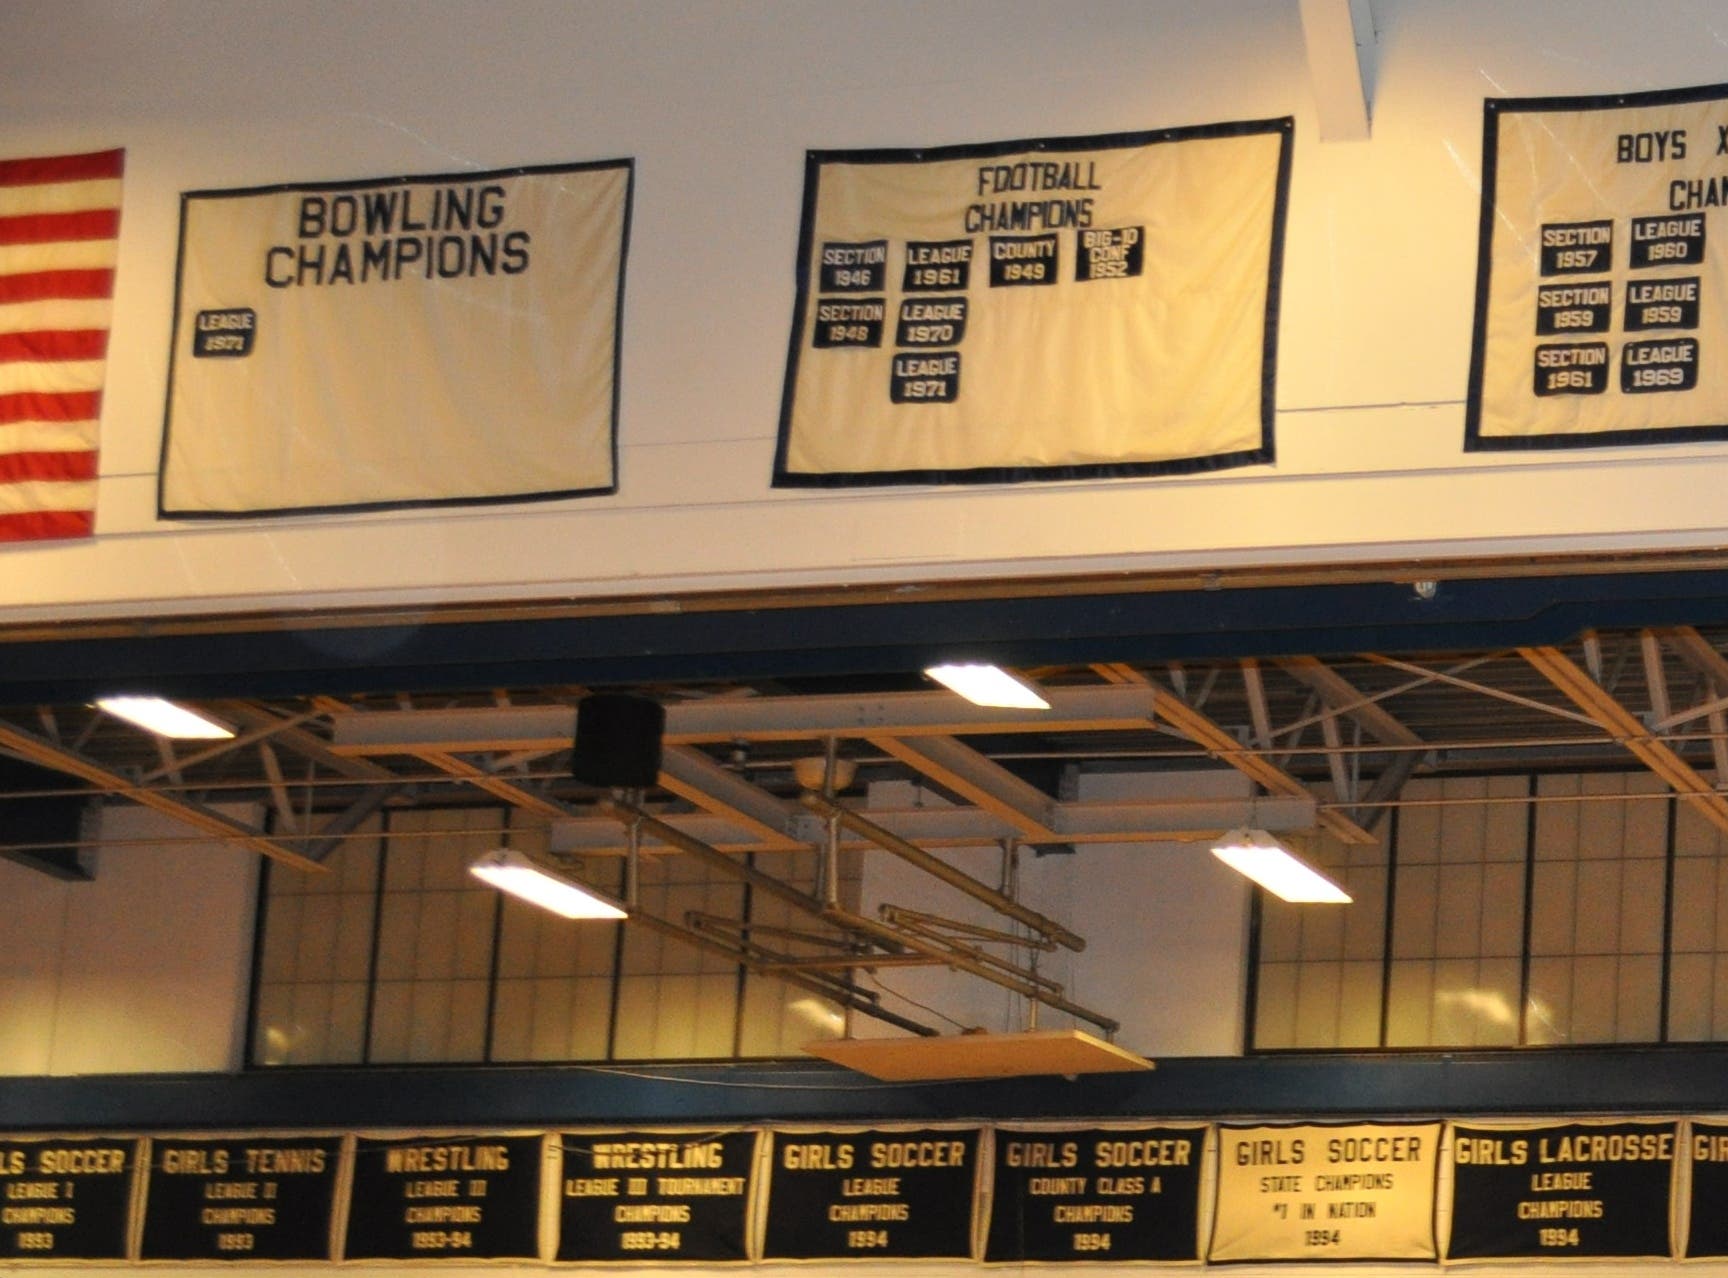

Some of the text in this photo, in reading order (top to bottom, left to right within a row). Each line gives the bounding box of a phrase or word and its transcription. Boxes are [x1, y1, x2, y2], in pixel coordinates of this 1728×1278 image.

[1616, 130, 1687, 163] BOYS
[978, 162, 1101, 196] FOOTBALL
[299, 185, 506, 238] BOWLING
[965, 198, 1096, 234] CHAMPIONS
[1083, 229, 1139, 248] BIG-10
[1543, 226, 1610, 247] SECTION
[1635, 219, 1702, 240] LEAGUE
[265, 231, 531, 288] CHAMPIONS
[823, 246, 886, 266] SECTION
[908, 245, 971, 265] LEAGUE
[992, 239, 1056, 261] COUNTY
[1089, 246, 1130, 263] CONF
[1556, 250, 1598, 268] 1957
[1648, 243, 1688, 260] 1960
[834, 270, 871, 286] 1946
[913, 269, 960, 286] 1961
[1003, 263, 1046, 281] 1949
[1538, 287, 1610, 307] SECTION
[1629, 283, 1697, 304] LEAGUE
[199, 313, 253, 330] LEAGUE
[819, 304, 883, 322] SECTION
[902, 303, 964, 321] LEAGUE
[1553, 310, 1594, 328] 1959
[1641, 306, 1682, 324] 1959
[905, 324, 953, 342] 1970
[1537, 348, 1606, 368] SECTION
[1626, 344, 1694, 364] LEAGUE
[896, 357, 958, 377] LEAGUE
[1633, 367, 1684, 386] 1969
[903, 380, 947, 398] 1971
[1547, 371, 1593, 389] 1961
[592, 1143, 724, 1170] WRESTLING
[784, 1142, 966, 1170] GIRLS SOCCER
[1006, 1140, 1191, 1168] GIRLS SOCCER
[1235, 1136, 1422, 1167] GIRLS SOCCER
[1455, 1133, 1675, 1165] GIRLS LACROSSE
[40, 1150, 125, 1174] SOCCER
[162, 1150, 230, 1174] GIRLS
[385, 1146, 510, 1173] WRESTLING
[842, 1178, 902, 1197] LEAGUE
[1028, 1177, 1145, 1195] COUNTY CLASS
[1259, 1173, 1394, 1194] STATE CHAMPIONS
[1531, 1172, 1593, 1192] LEAGUE
[405, 1206, 482, 1223] CHAMPIONS
[614, 1205, 691, 1223] CHAMPIONS
[828, 1204, 910, 1222] CHAMPIONS
[1053, 1205, 1134, 1223] CHAMPIONS
[1328, 1202, 1377, 1219] NATION
[1517, 1200, 1604, 1220] CHAMPIONS
